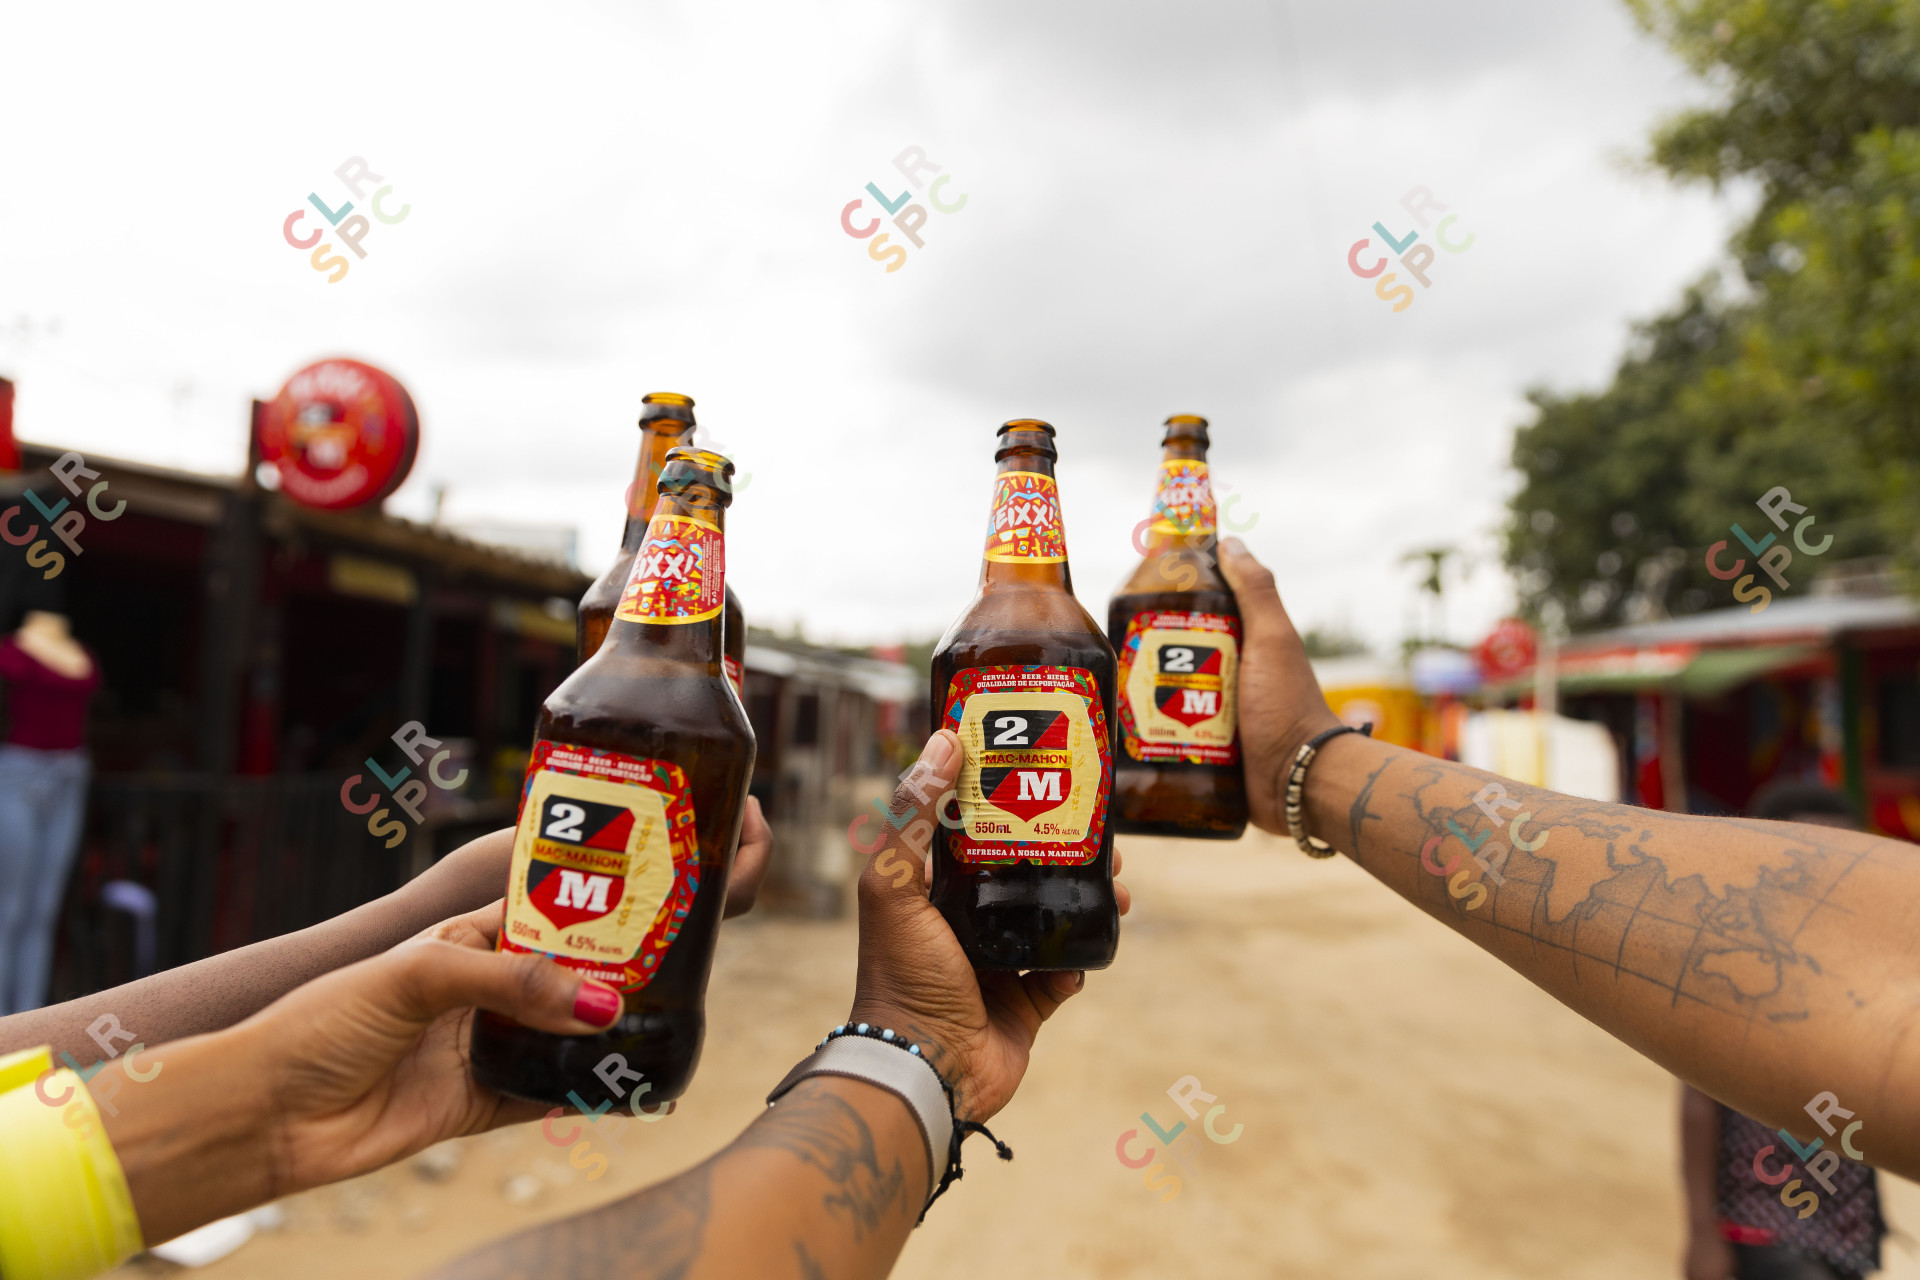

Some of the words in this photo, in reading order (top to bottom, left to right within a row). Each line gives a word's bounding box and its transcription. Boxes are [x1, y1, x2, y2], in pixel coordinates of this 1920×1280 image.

[1164, 647, 1194, 672] 2
[977, 680, 1017, 688] QUALIDADE
[1028, 680, 1075, 688] EXPORTAÇÃO
[1181, 689, 1217, 715] M
[993, 716, 1029, 746] 2
[1017, 771, 1063, 801] M
[544, 803, 586, 842] 2
[1034, 823, 1060, 836] 4.5%
[966, 848, 1008, 856] REFRESCA
[1017, 849, 1046, 857] NOSSA
[1047, 850, 1085, 858] MANEIRA
[554, 870, 614, 913] M
